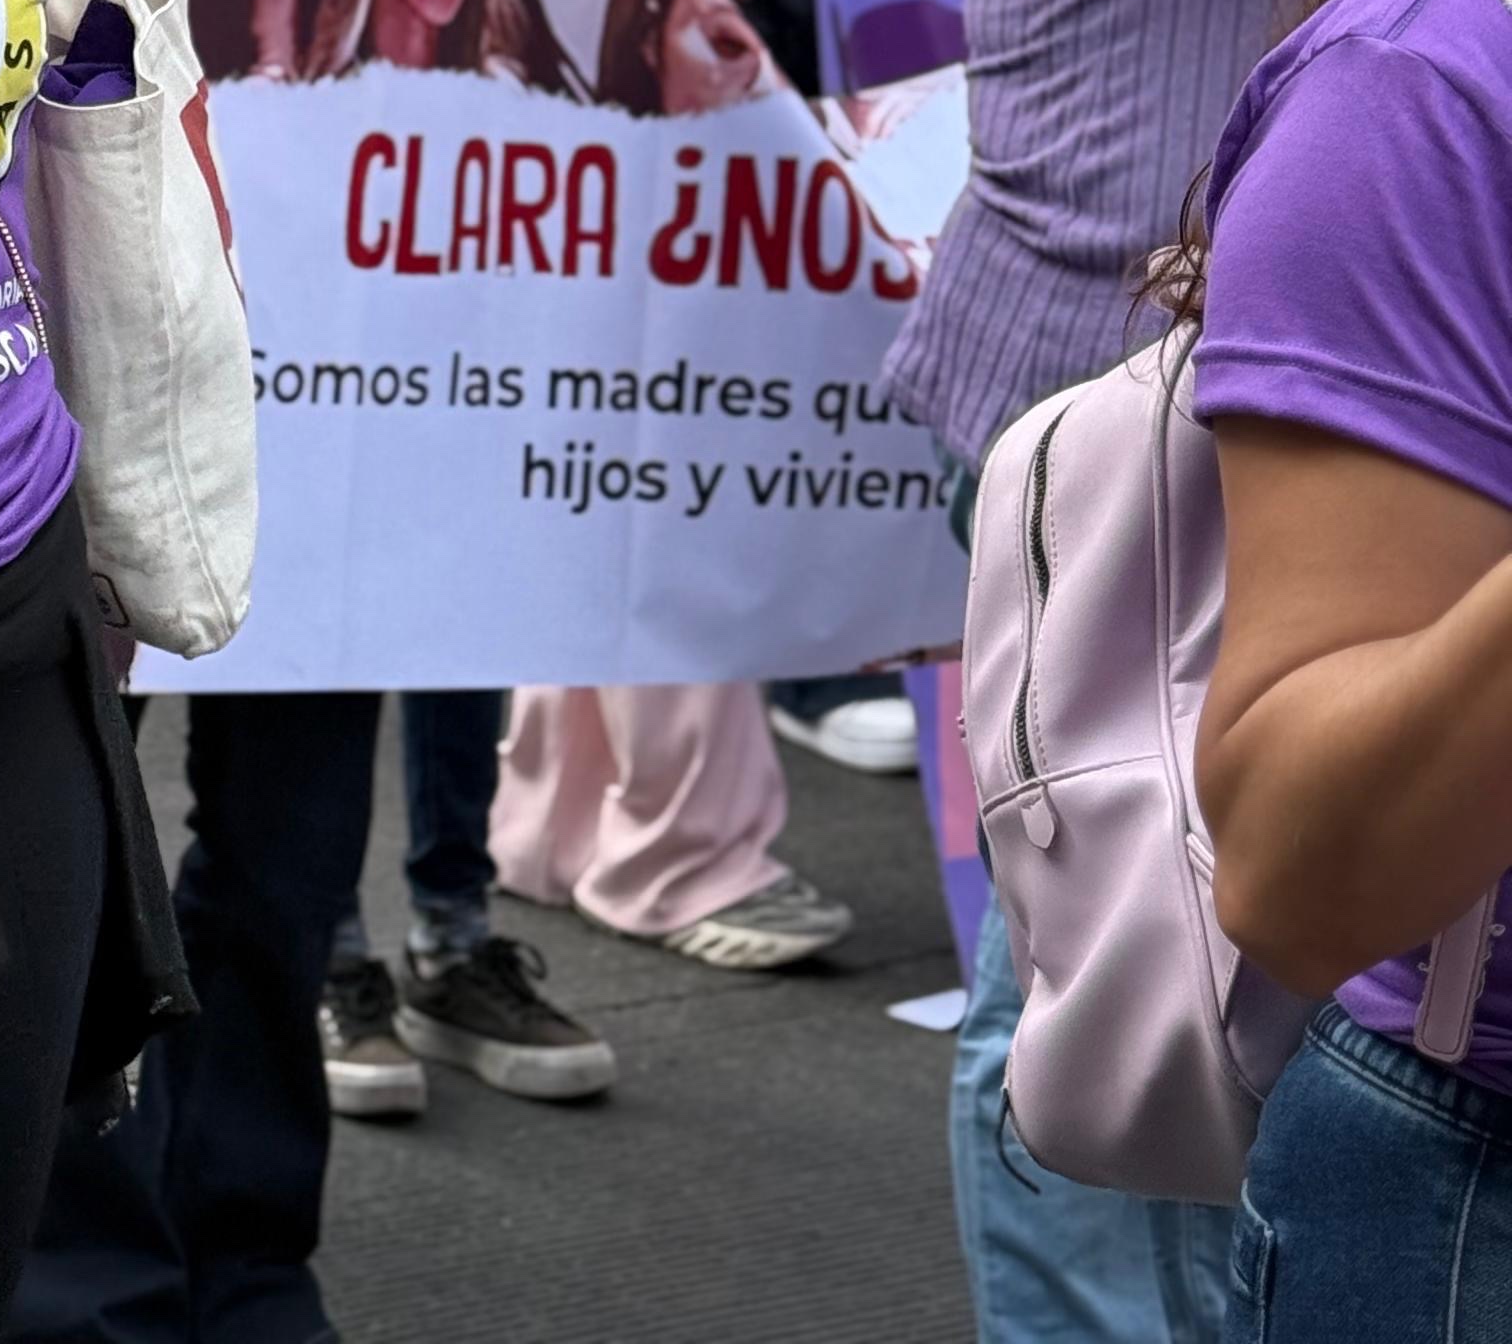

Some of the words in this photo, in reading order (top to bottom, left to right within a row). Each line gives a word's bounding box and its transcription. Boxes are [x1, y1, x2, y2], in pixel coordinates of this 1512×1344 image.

[345, 132, 617, 278] CLARA
[448, 351, 524, 409] las
[548, 359, 793, 422] madres
[521, 441, 668, 516] hijos
[685, 462, 725, 517] y
